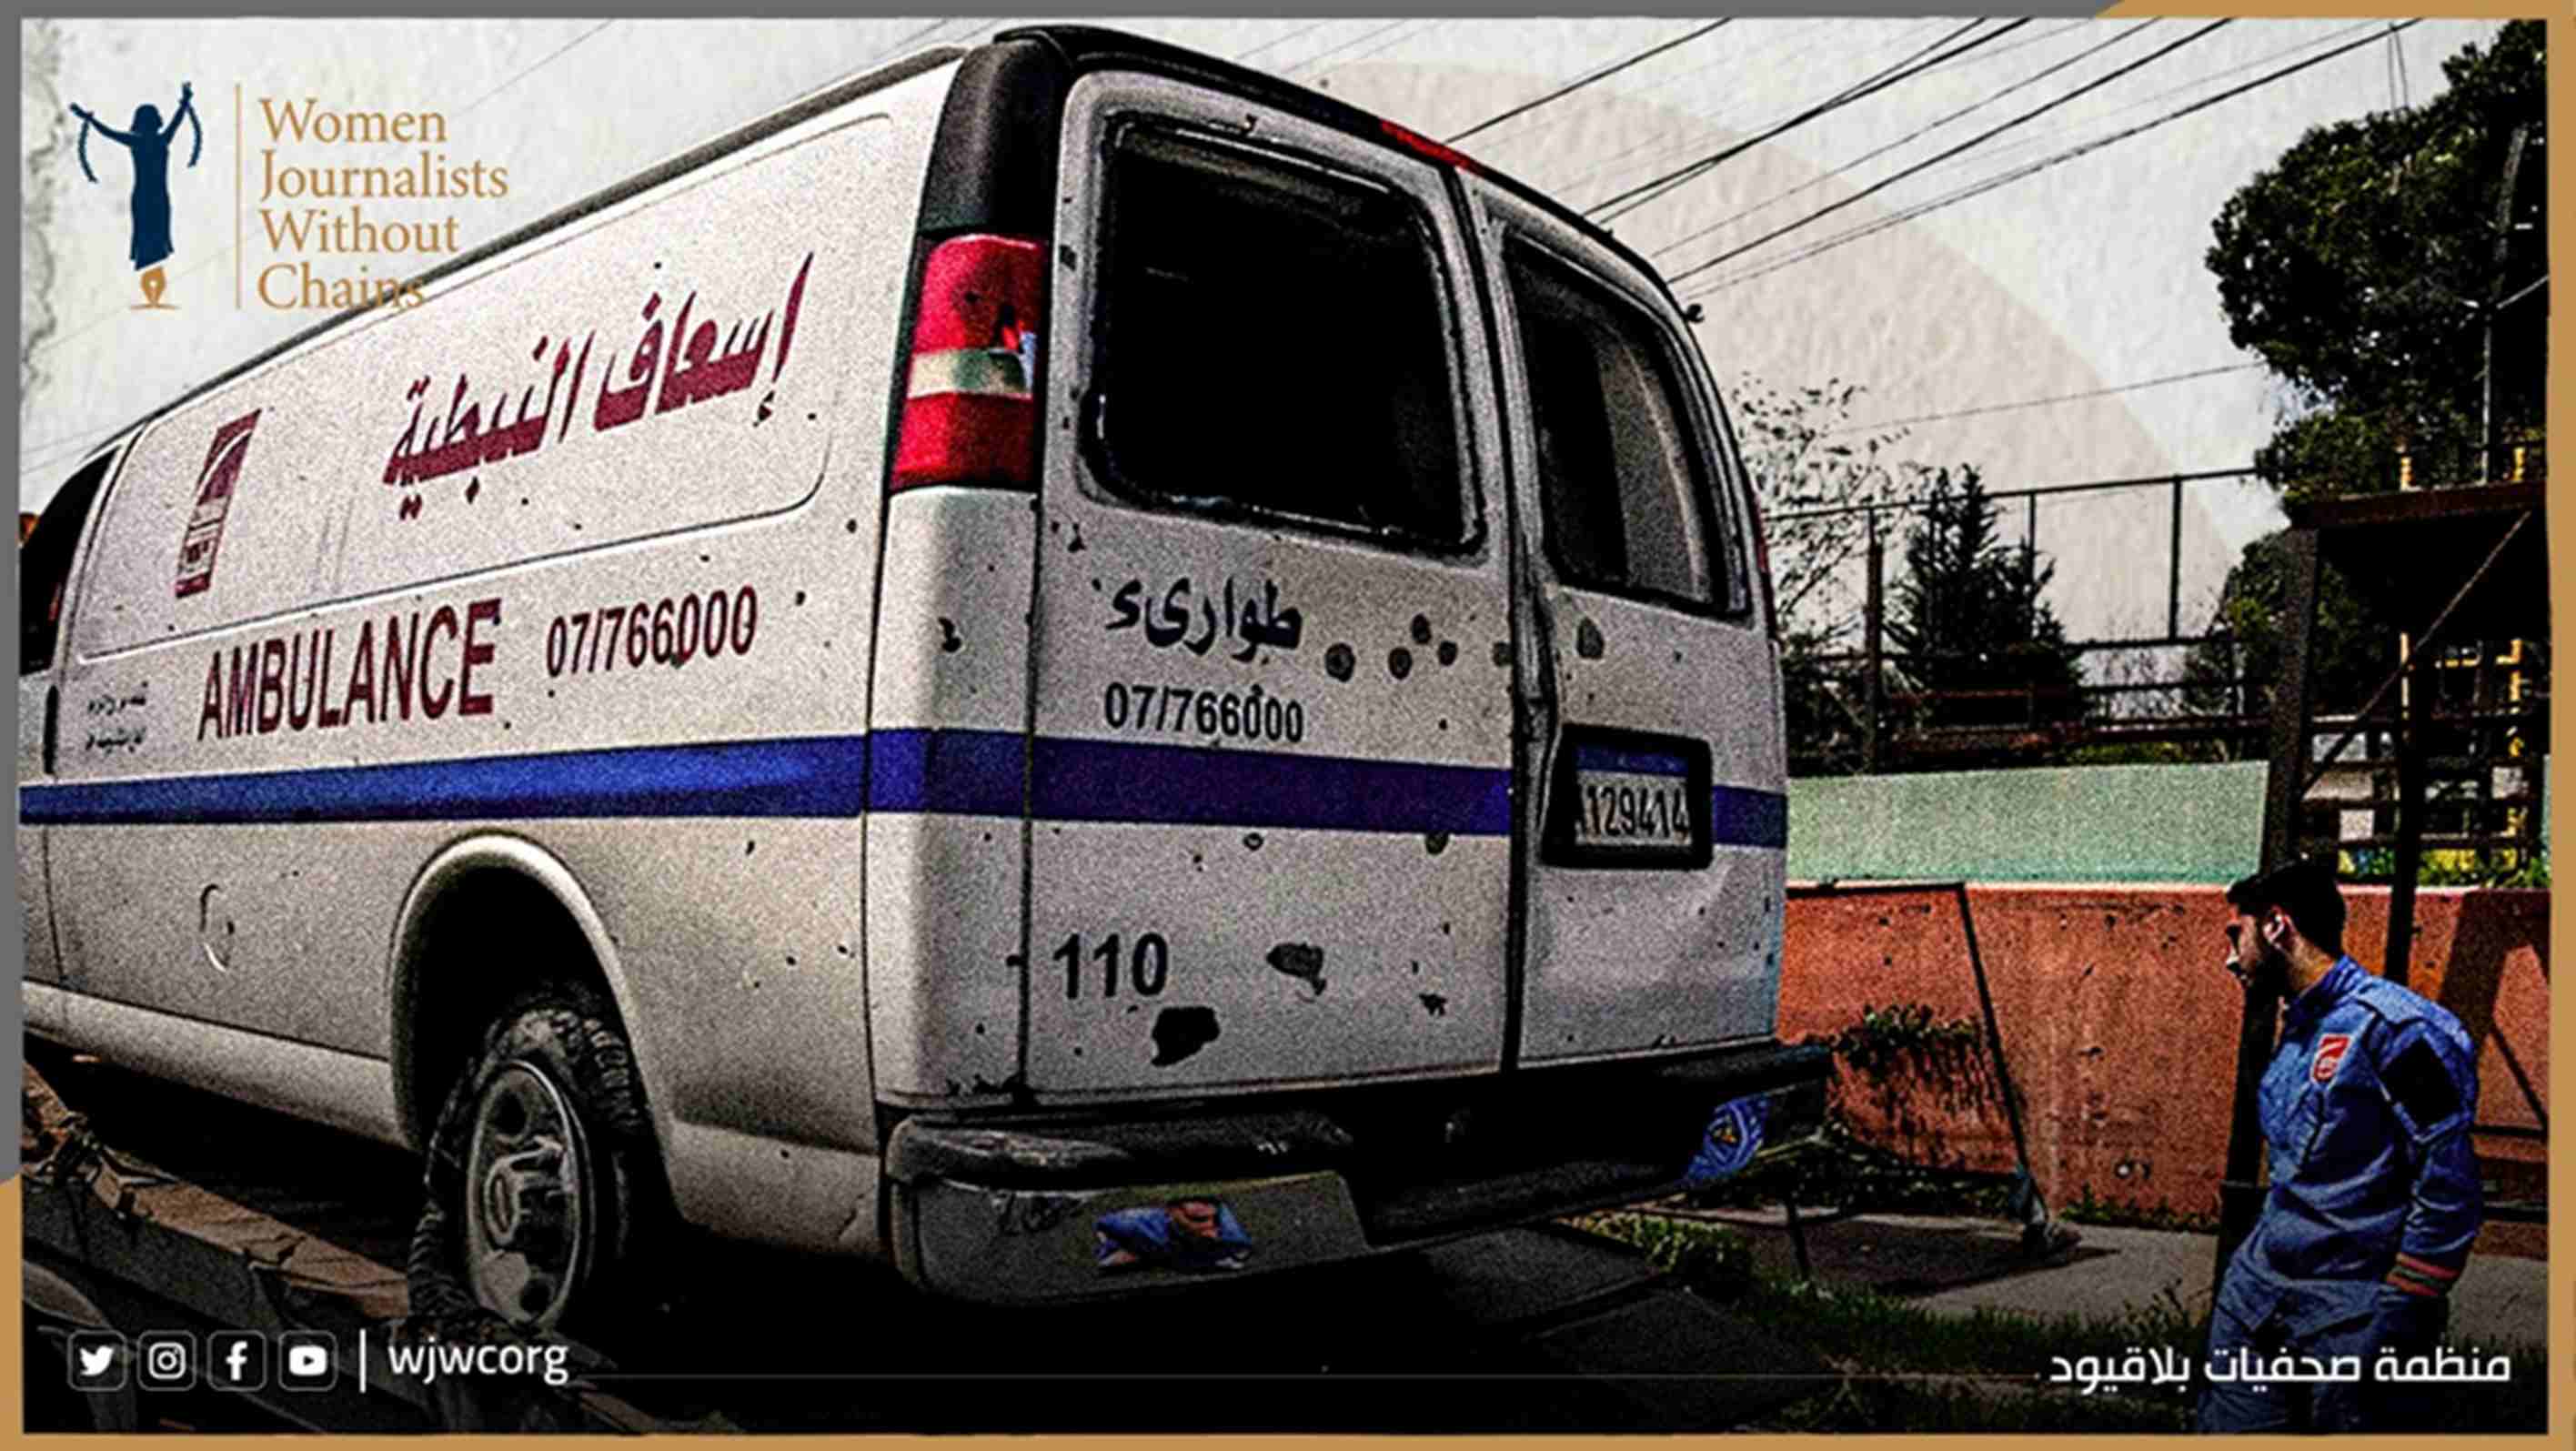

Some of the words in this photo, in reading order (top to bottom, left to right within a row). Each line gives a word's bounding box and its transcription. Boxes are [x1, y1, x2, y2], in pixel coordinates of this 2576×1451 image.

[593, 252, 814, 431] إسعاف
[383, 330, 595, 519] النبطية
[196, 598, 501, 741] AMBULANCE
[548, 586, 759, 678] 07/766000
[1104, 681, 1304, 743] 07/766000
[1052, 932, 1168, 1000] 110
